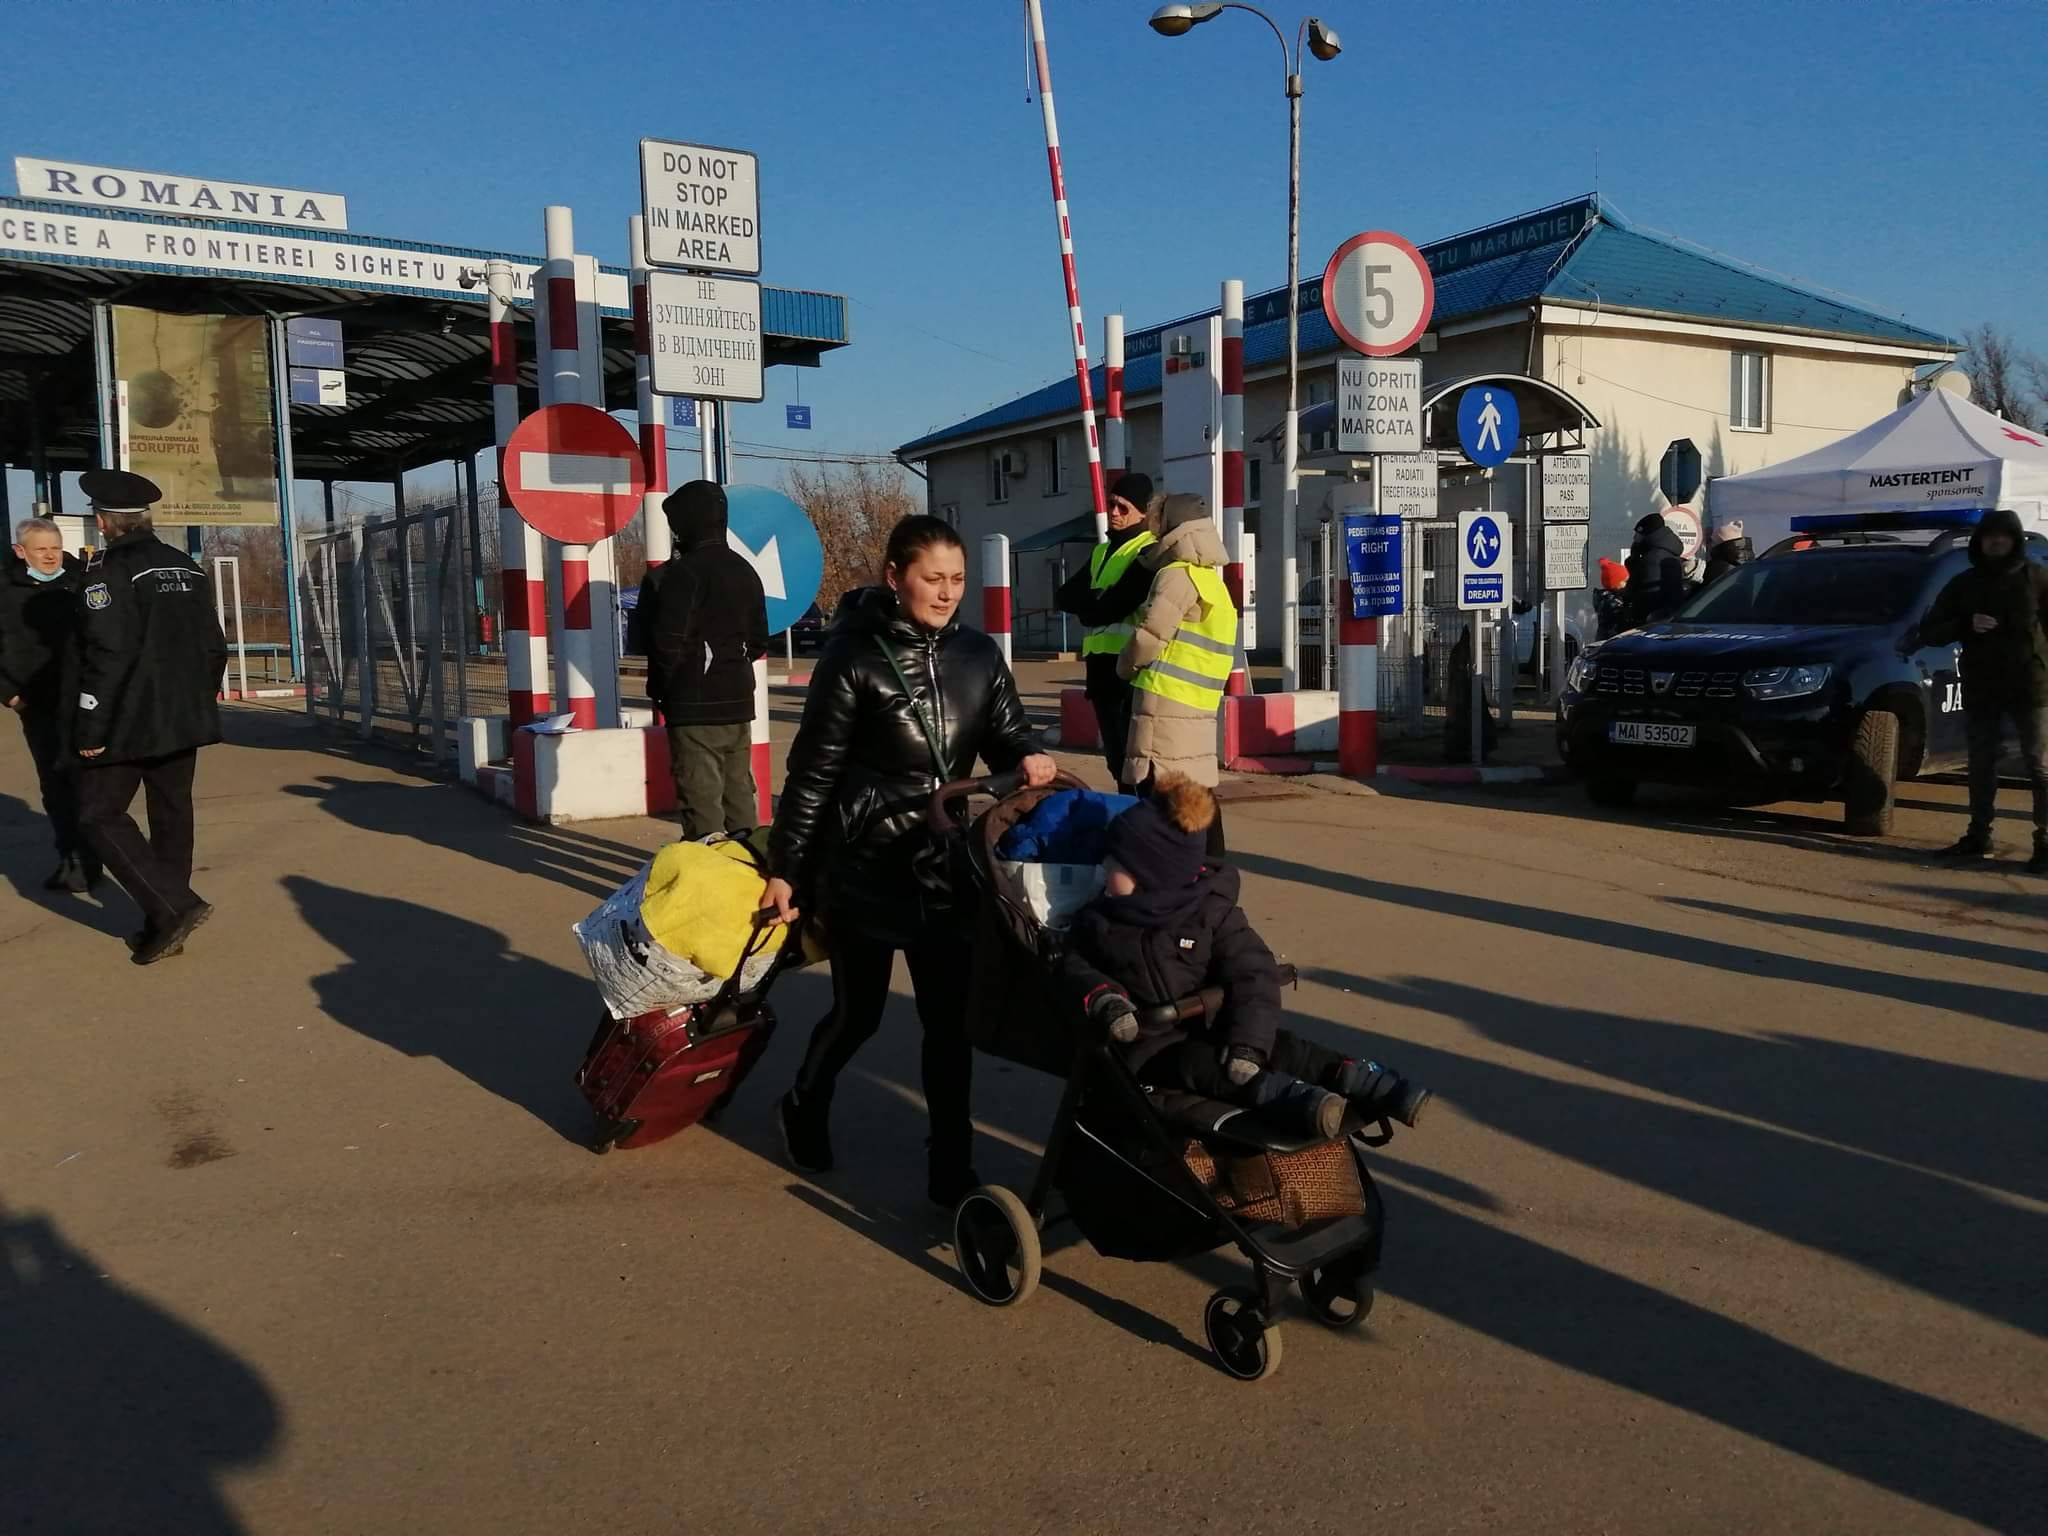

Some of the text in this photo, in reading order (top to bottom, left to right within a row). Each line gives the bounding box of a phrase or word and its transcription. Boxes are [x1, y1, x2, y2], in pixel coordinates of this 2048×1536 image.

[663, 152, 738, 181] DO NOT
[45, 168, 326, 221] ROMÂNIA
[676, 182, 728, 207] STOP
[651, 206, 754, 238] IN MARKED
[96, 229, 111, 250] A
[146, 234, 314, 268] FRONTIEREI
[677, 238, 732, 263] AREA
[698, 281, 716, 301] НЕ
[1365, 264, 1394, 329] 5
[656, 304, 756, 332] ЗУПИНЯЙТЕСЬ
[658, 334, 756, 361] В ВІДМІЧЕНІЙ
[692, 366, 725, 387] ЗОНІ
[1341, 370, 1416, 389] NU OPRITI
[1347, 394, 1409, 412] IN ZONA
[1341, 418, 1414, 436] MARCATA
[1553, 457, 1581, 469] ATTENTION
[1396, 468, 1423, 481] RADIATII
[1544, 473, 1589, 485] RADIATION CONTROL
[1869, 468, 1974, 488] MASTERTENT
[1382, 486, 1405, 498] TRECETI
[1406, 486, 1420, 498] FARA
[1560, 489, 1575, 501] PASS
[1927, 484, 1985, 500] sponsoring
[1567, 506, 1588, 517] STOPPING
[1386, 526, 1400, 535] KEEP
[1361, 541, 1389, 554] RIGHT
[1468, 589, 1500, 600] DREAPTA
[1618, 724, 1689, 743] MAI 53502
